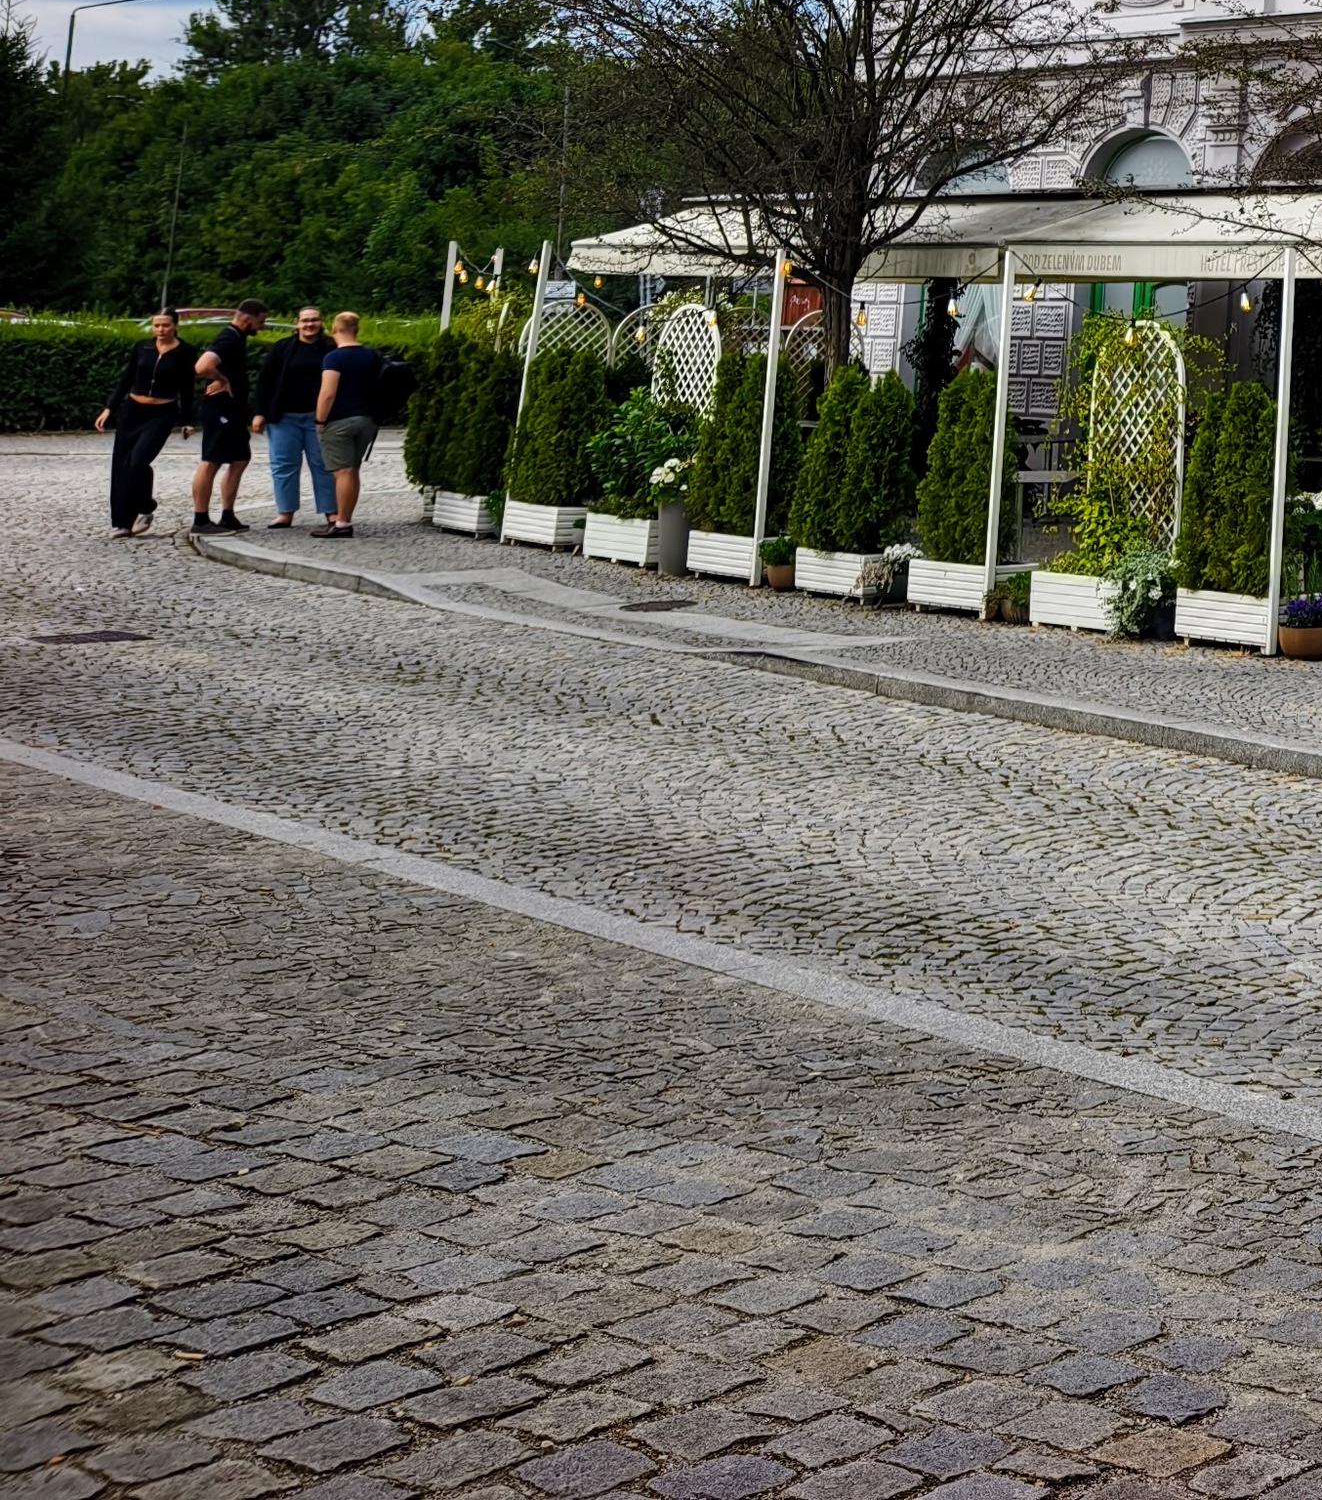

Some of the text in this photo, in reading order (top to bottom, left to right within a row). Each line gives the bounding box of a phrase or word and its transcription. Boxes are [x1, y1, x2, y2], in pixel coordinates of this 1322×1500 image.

[1021, 250, 1122, 271] POD ZELENÝM DUBEM
